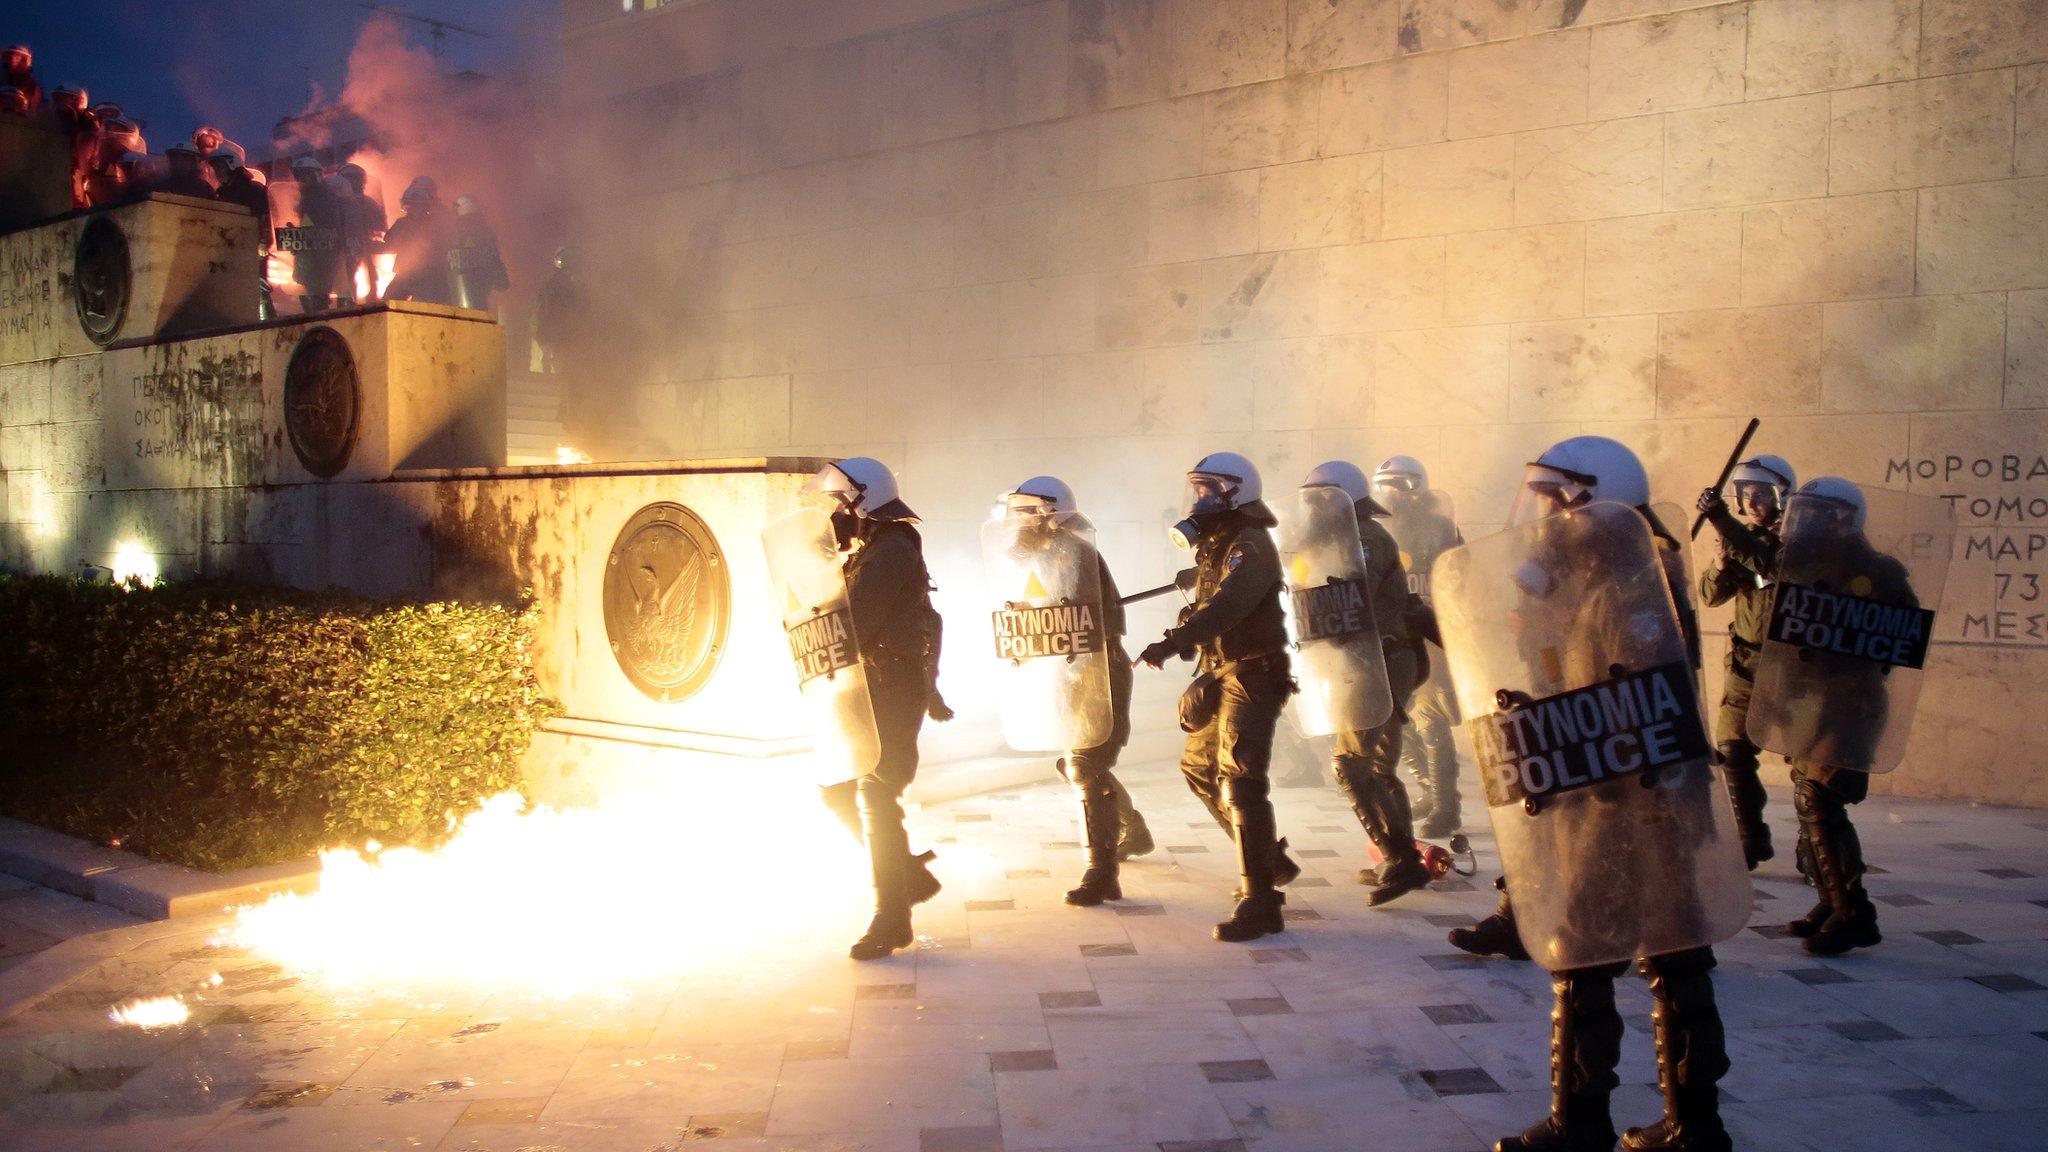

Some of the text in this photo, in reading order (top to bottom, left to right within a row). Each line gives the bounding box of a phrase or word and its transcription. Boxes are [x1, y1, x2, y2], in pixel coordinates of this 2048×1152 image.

[282, 240, 336, 251] POLICE
[1940, 494, 2048, 522] ΤΟΜΟ
[1994, 573, 2041, 601] 73
[995, 605, 1095, 637] ΑΣΤΥΝΟΜΙΑ
[1780, 586, 1923, 641] ΑΣΤΥΝΟΜΙΑ
[1963, 611, 2048, 640] ΜΕΣ
[999, 631, 1090, 658] POLICE
[1781, 616, 1914, 665] POLICE
[794, 642, 849, 681] LICE
[1479, 672, 1683, 763] ΑΣΤΥΝΟΜΙΑ
[1493, 721, 1683, 802] POLICE
